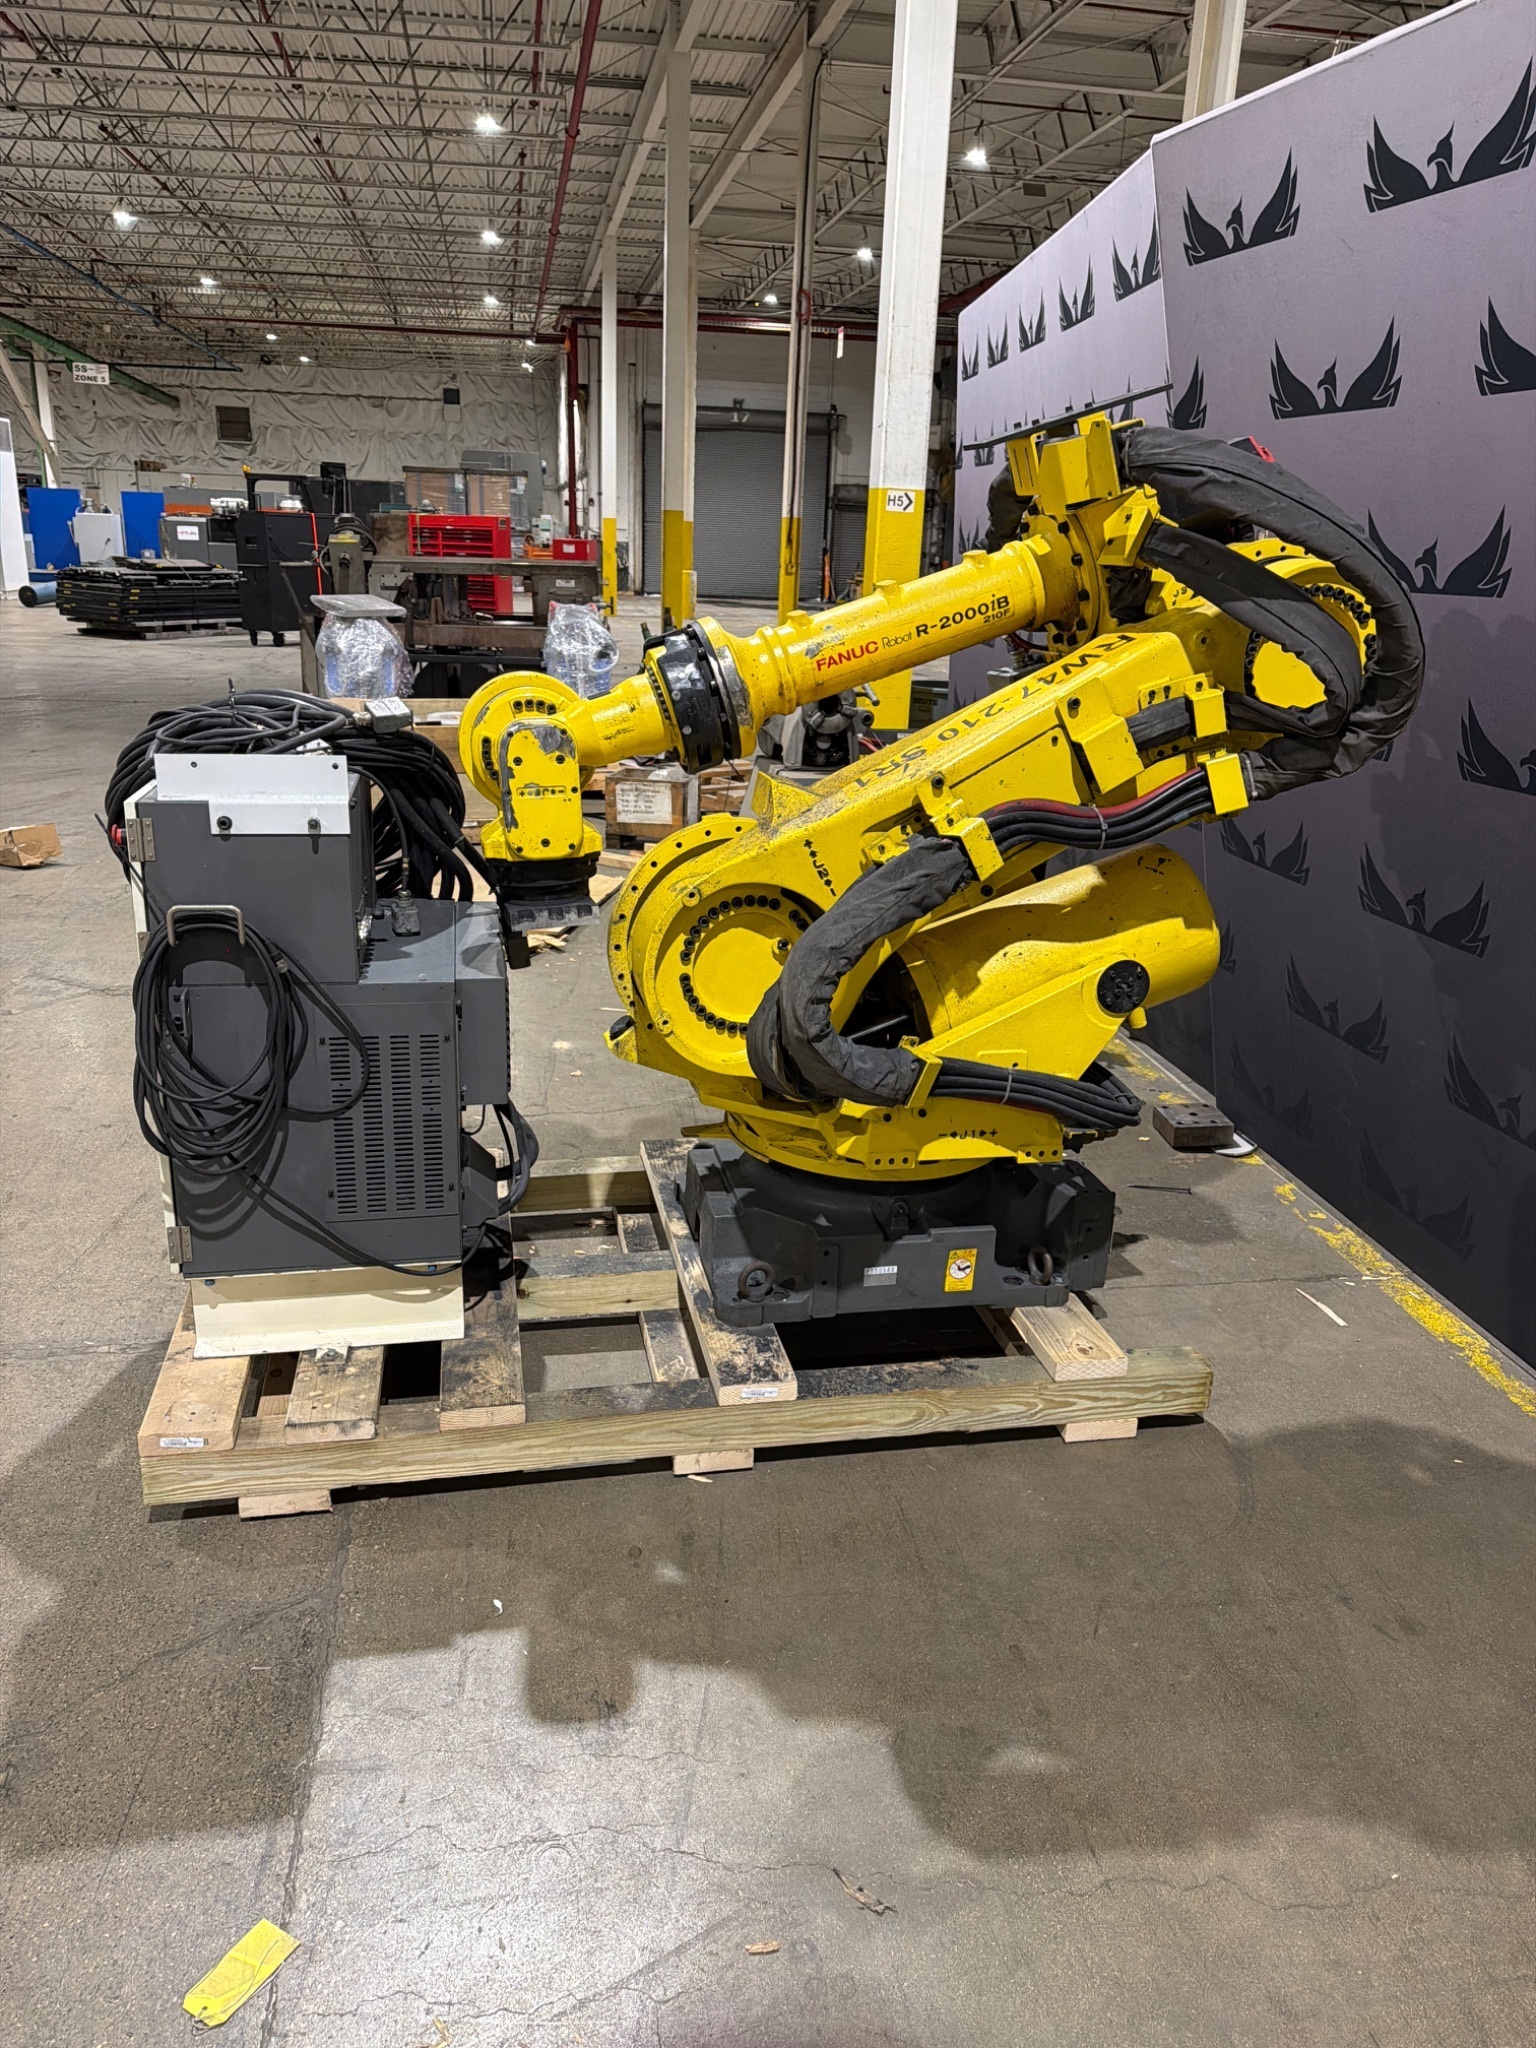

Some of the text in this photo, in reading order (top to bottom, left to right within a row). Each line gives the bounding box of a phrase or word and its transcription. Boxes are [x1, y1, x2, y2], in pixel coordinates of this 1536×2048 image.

[74, 374, 99, 382] ZONE
[730, 411, 750, 423] 17
[887, 494, 904, 507] H5
[983, 607, 1011, 624] 210F
[815, 594, 1011, 672] FANUC Robot R-2000iB
